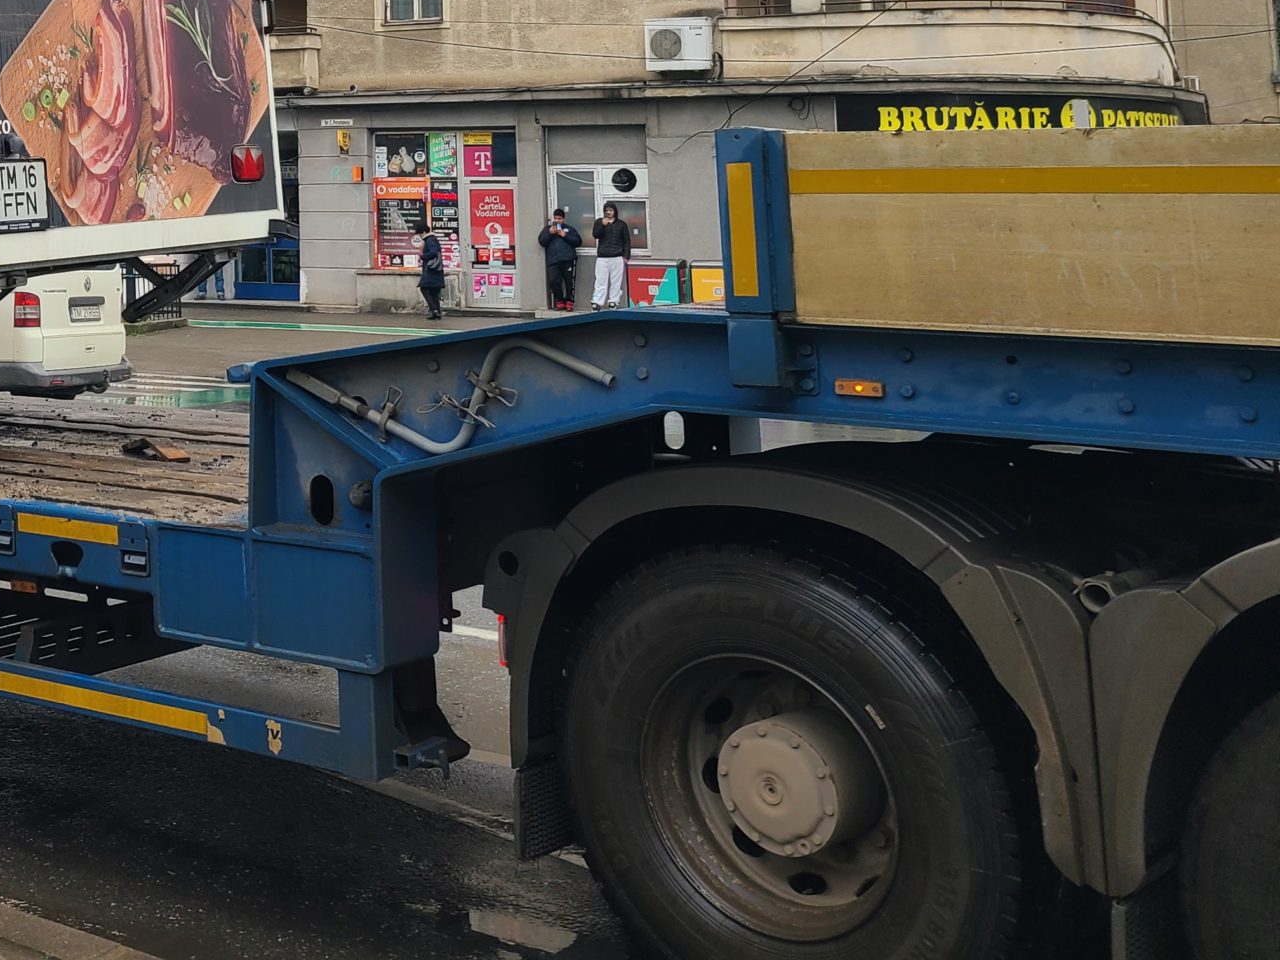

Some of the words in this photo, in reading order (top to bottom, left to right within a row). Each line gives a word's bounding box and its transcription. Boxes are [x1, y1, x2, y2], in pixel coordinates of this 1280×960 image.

[877, 100, 1052, 132] BRUTĂRIE
[22, 165, 38, 189] 16
[388, 185, 425, 194] vodafone
[3, 191, 38, 218] FFN
